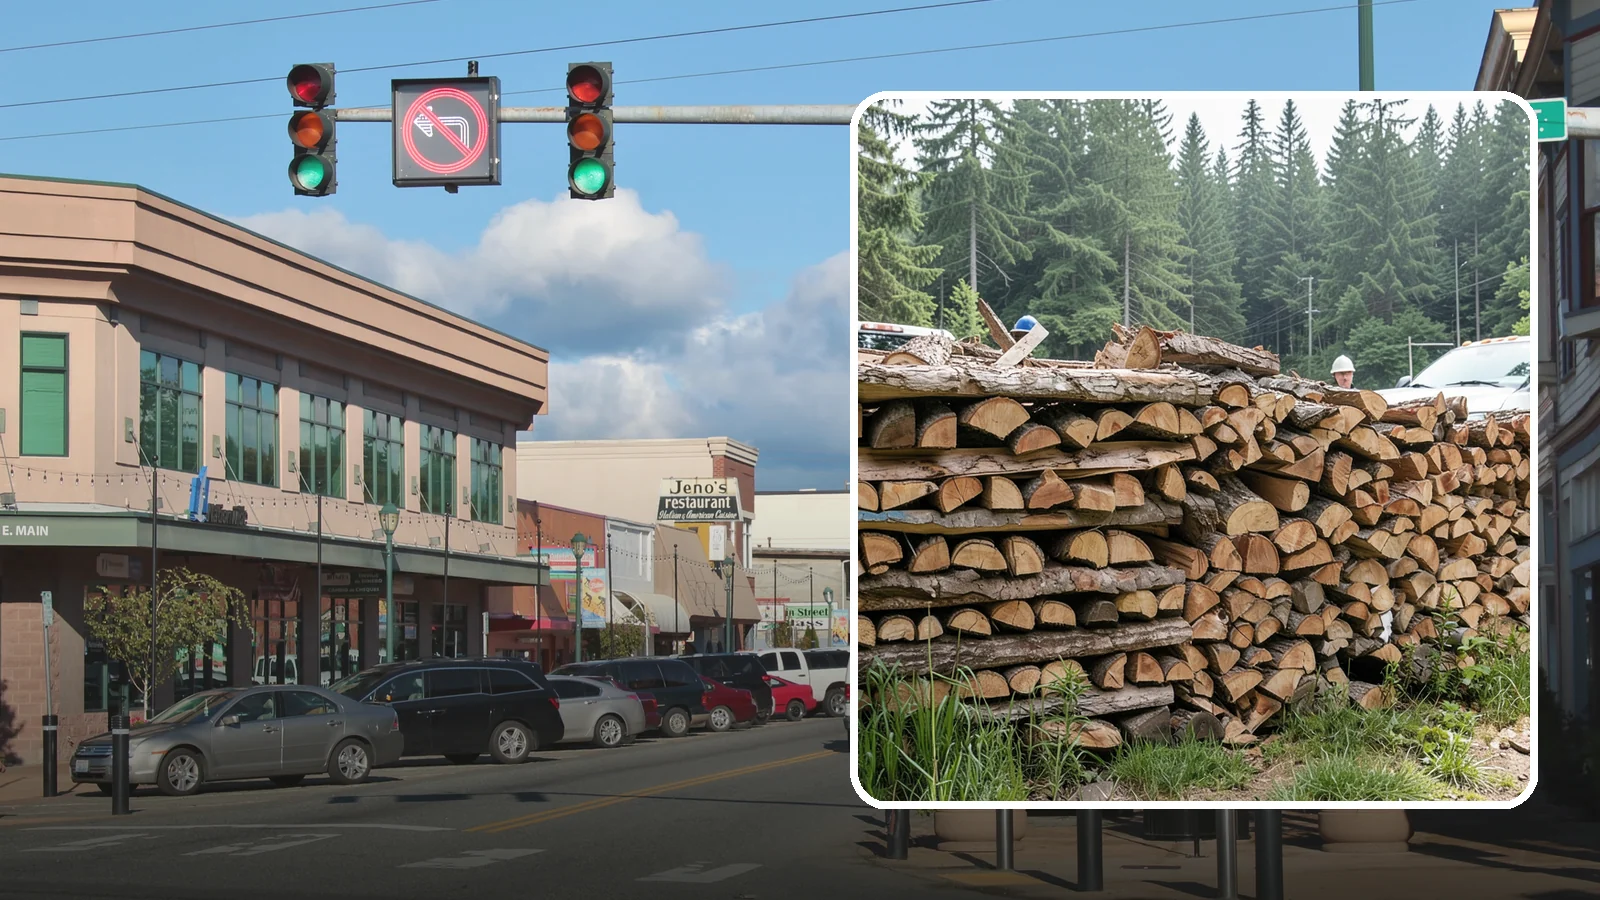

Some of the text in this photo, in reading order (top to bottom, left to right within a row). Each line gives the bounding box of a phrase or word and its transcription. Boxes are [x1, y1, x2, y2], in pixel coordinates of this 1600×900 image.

[670, 480, 727, 494] Jeno's
[665, 496, 731, 509] restaurant
[659, 510, 681, 519] Italian
[686, 510, 714, 519] American
[715, 510, 737, 519] Cuisine
[2, 525, 49, 536] E. MAIN
[797, 608, 828, 617] Street
